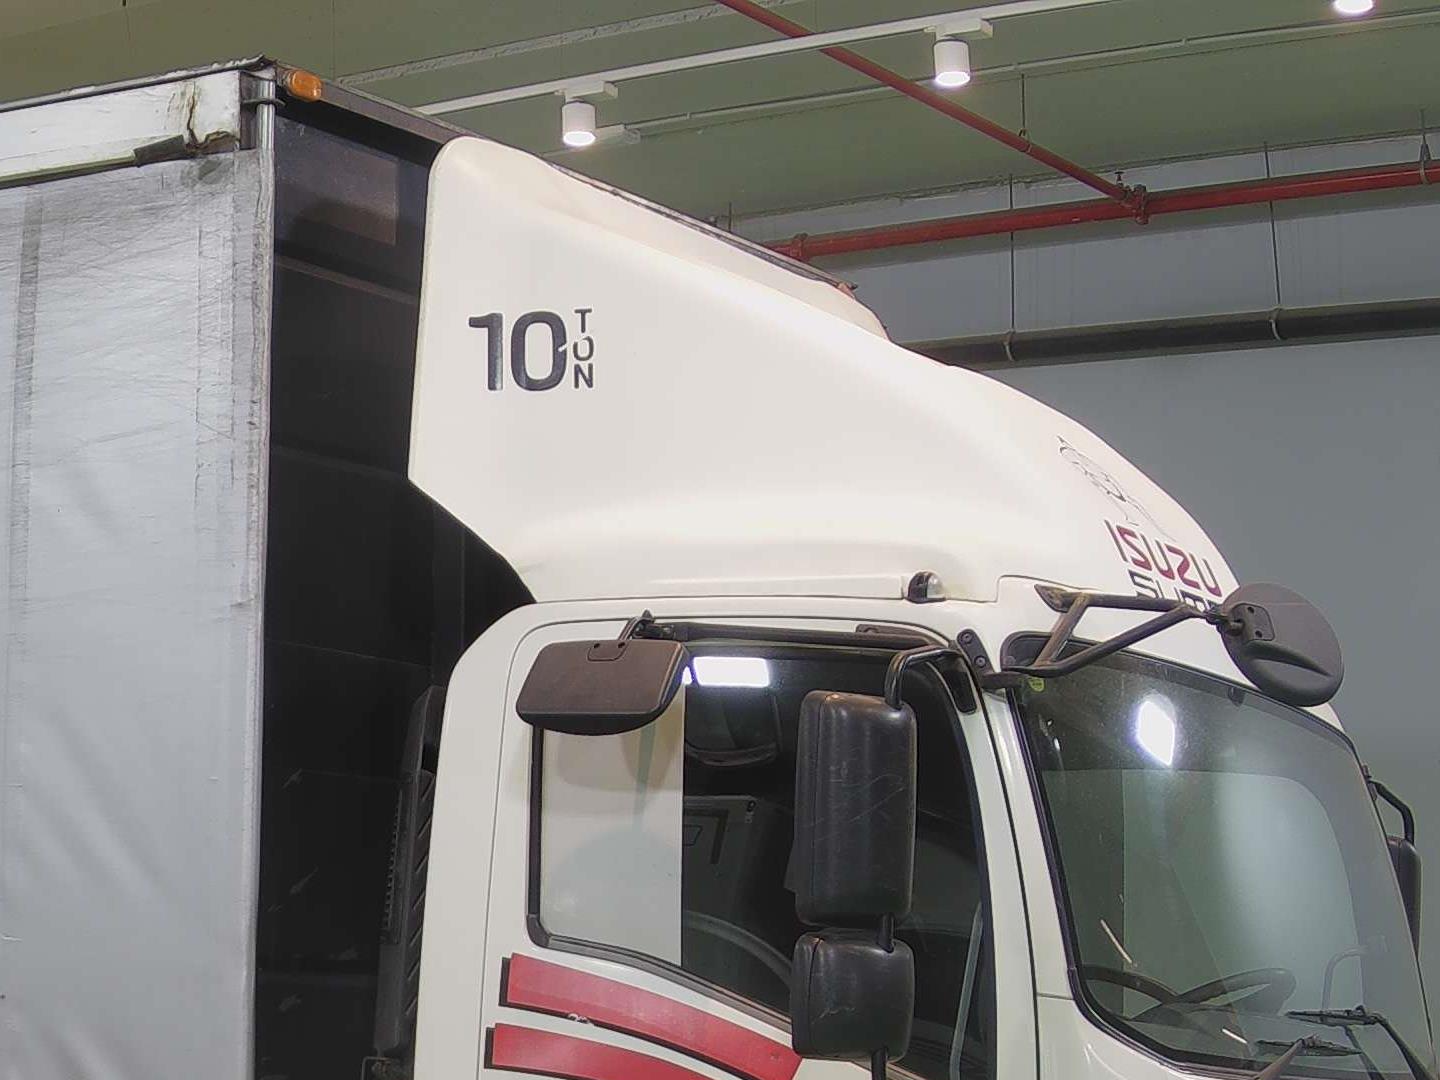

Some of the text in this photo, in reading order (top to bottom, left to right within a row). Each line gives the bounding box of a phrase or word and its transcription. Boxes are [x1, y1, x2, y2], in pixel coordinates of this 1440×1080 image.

[468, 311, 567, 391] 10
[572, 308, 594, 389] TON
[1104, 519, 1222, 598] ISUZU
